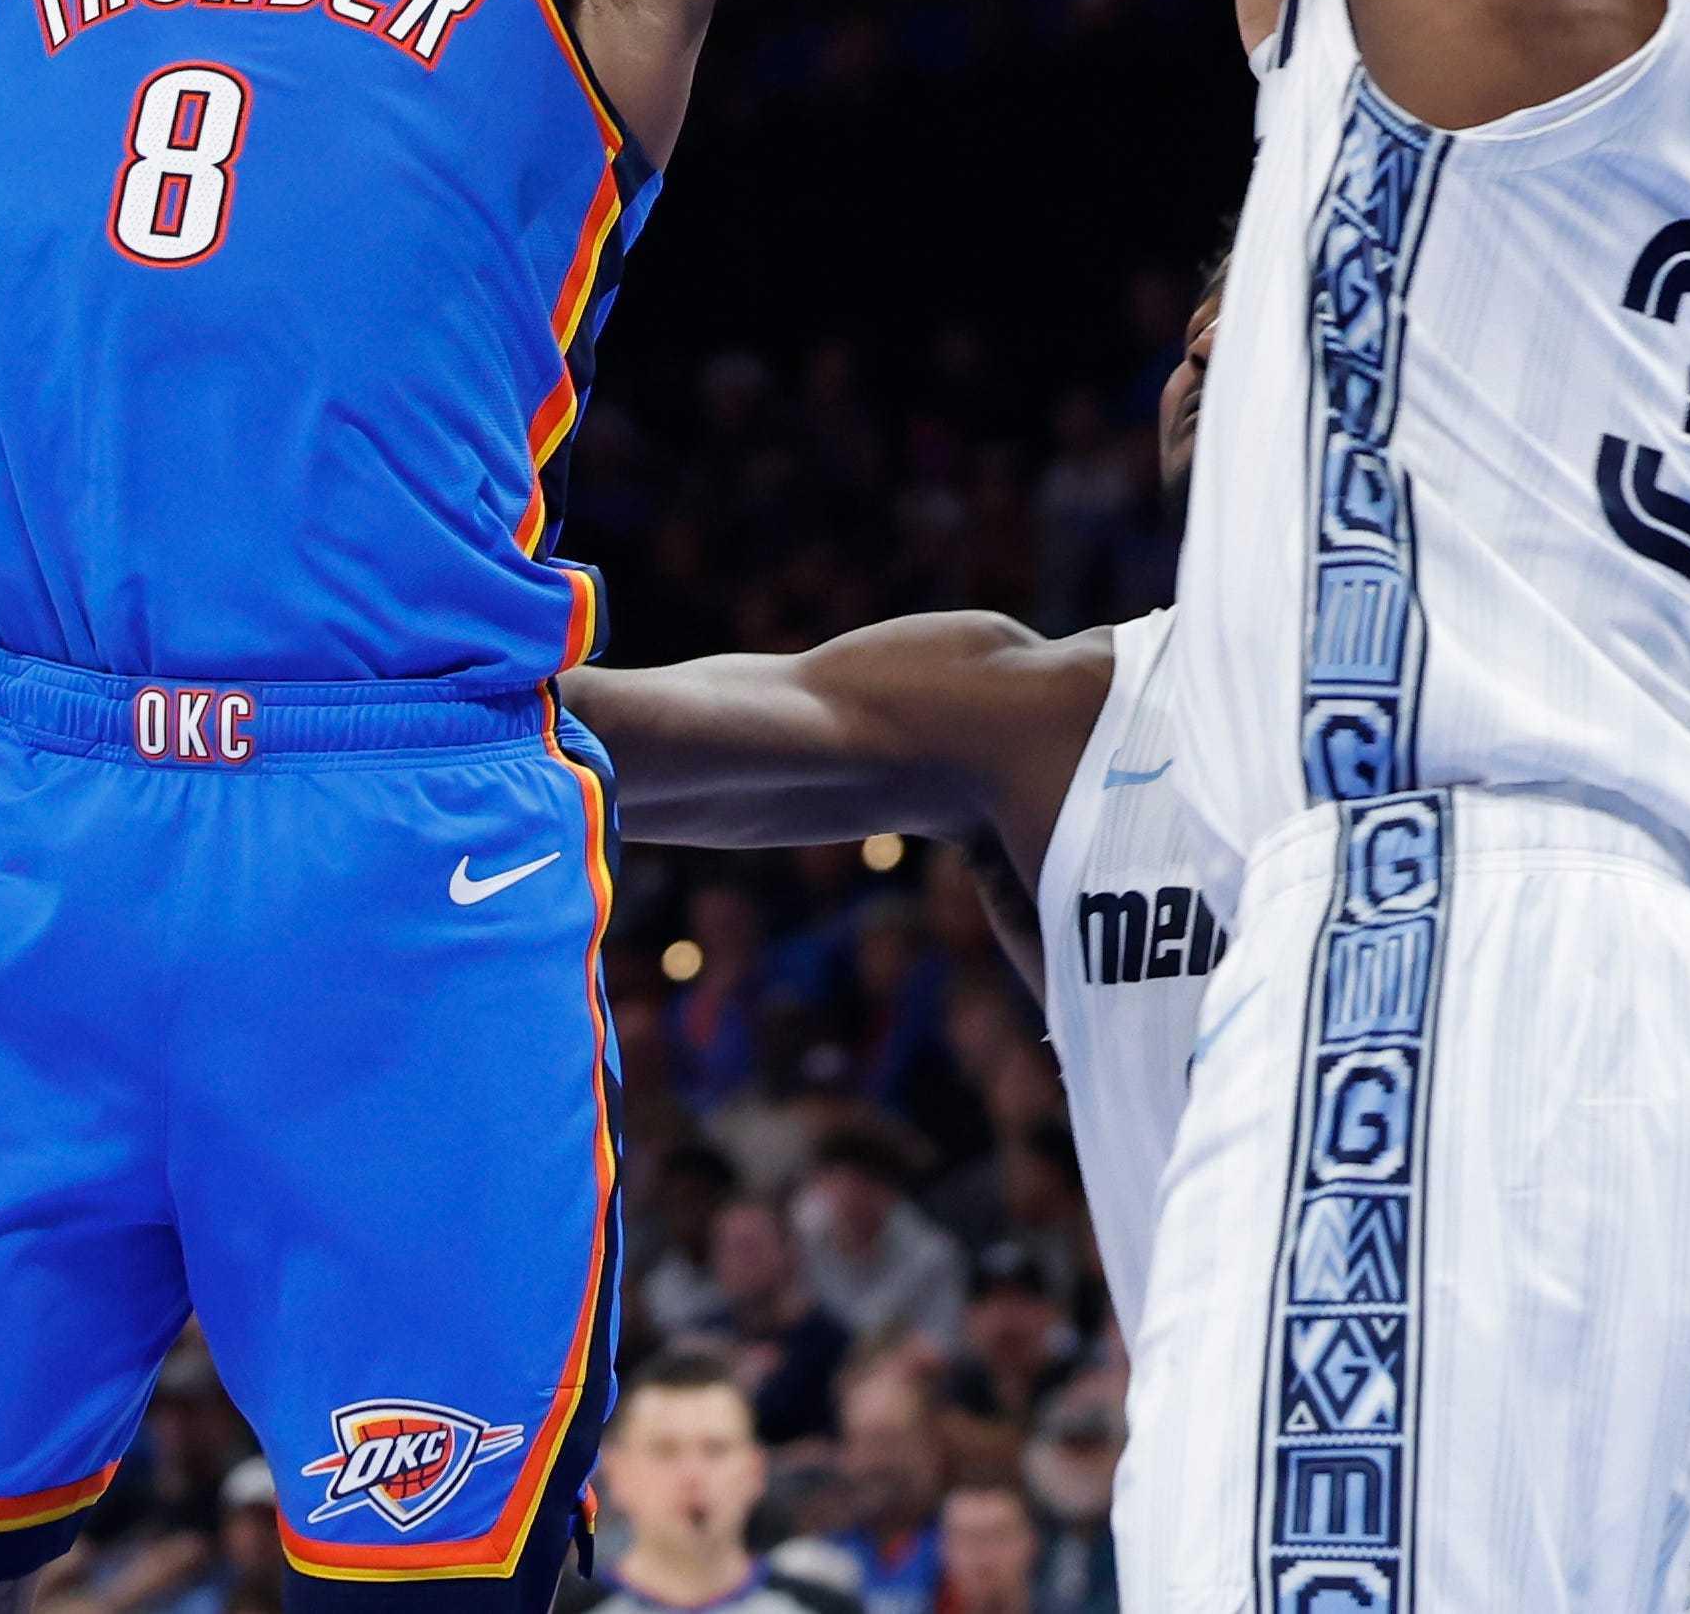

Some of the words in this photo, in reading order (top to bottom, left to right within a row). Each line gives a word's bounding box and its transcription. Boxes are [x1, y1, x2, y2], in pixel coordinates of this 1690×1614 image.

[106, 59, 252, 269] 8
[133, 686, 255, 766] OKC
[335, 1429, 450, 1496] OKC
